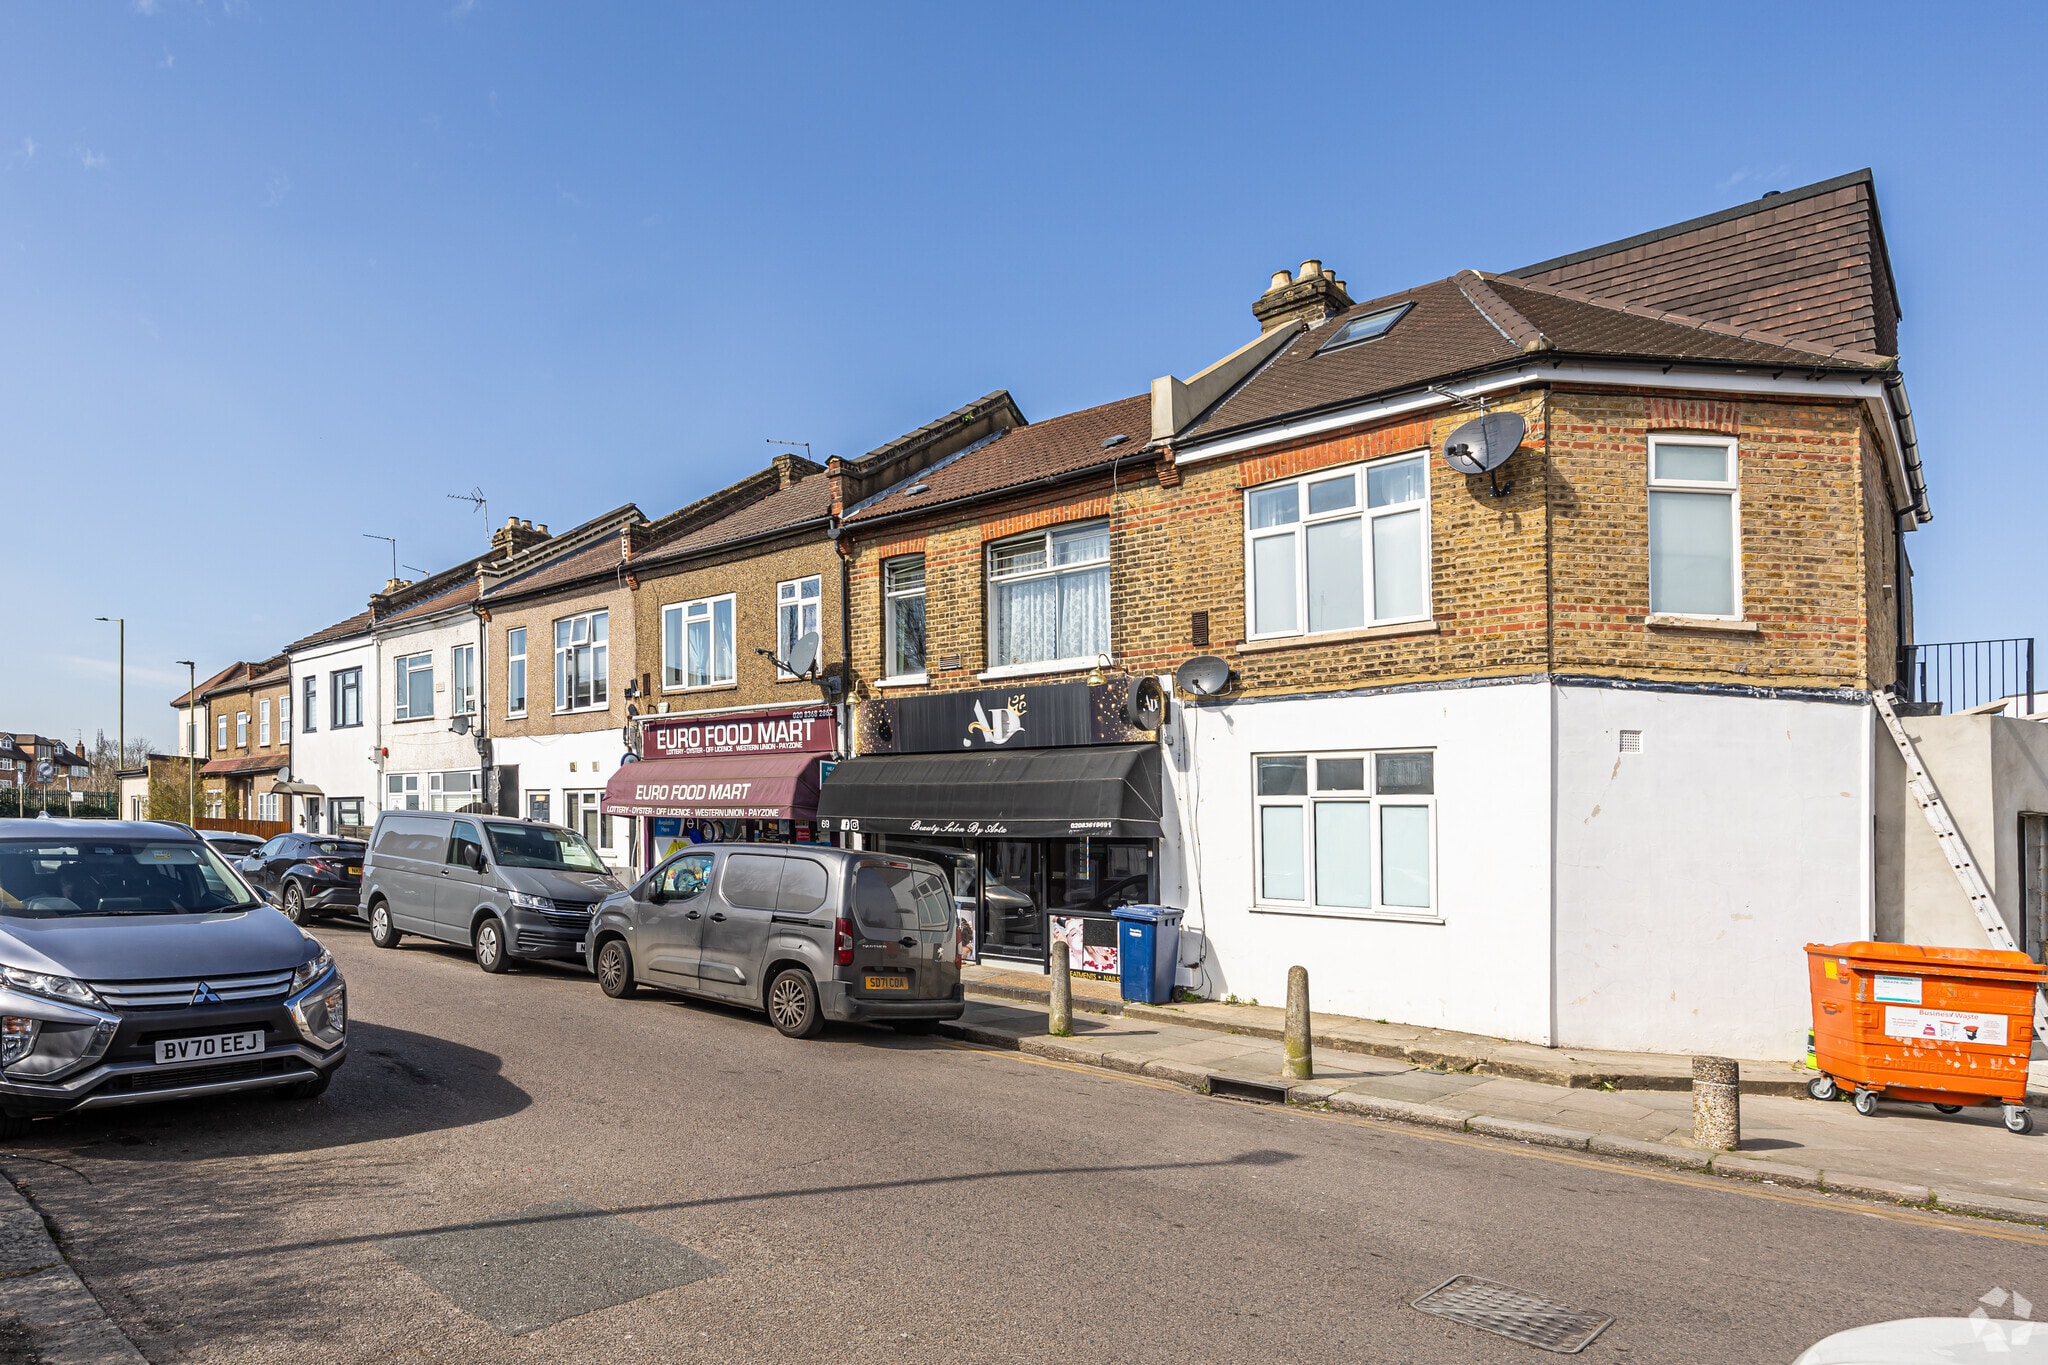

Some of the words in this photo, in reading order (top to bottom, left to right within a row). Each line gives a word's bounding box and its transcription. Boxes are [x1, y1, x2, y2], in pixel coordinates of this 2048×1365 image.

[792, 711, 803, 719] 020
[656, 727, 701, 750] EURO
[705, 723, 753, 747] FOOD
[757, 718, 816, 743] MART
[666, 748, 684, 756] LOTTERY
[686, 746, 703, 754] OYSTER
[736, 743, 760, 752] WESTERN
[778, 741, 803, 749] PAYZONE
[635, 784, 669, 800] EURO
[670, 784, 707, 800] FOOD
[708, 783, 752, 800] MART
[606, 805, 630, 813] LOTTERY
[631, 806, 653, 815] OYSTER
[656, 807, 667, 816] OFF
[667, 808, 691, 816] LICENCE
[695, 808, 724, 816] WESTERN
[724, 808, 745, 817] UNION
[748, 808, 779, 817] PAYZONE
[821, 819, 830, 829] 69
[909, 820, 940, 835] Beauty
[940, 821, 965, 833] Salon
[967, 821, 984, 836] By
[870, 977, 888, 988] SD71
[1069, 970, 1097, 981] EATMENTS
[1103, 974, 1121, 983] NAILS
[1919, 1009, 1953, 1018] Business
[1954, 1012, 1980, 1021] Waste
[164, 1038, 215, 1060] BV70
[221, 1033, 257, 1053] EEJ
